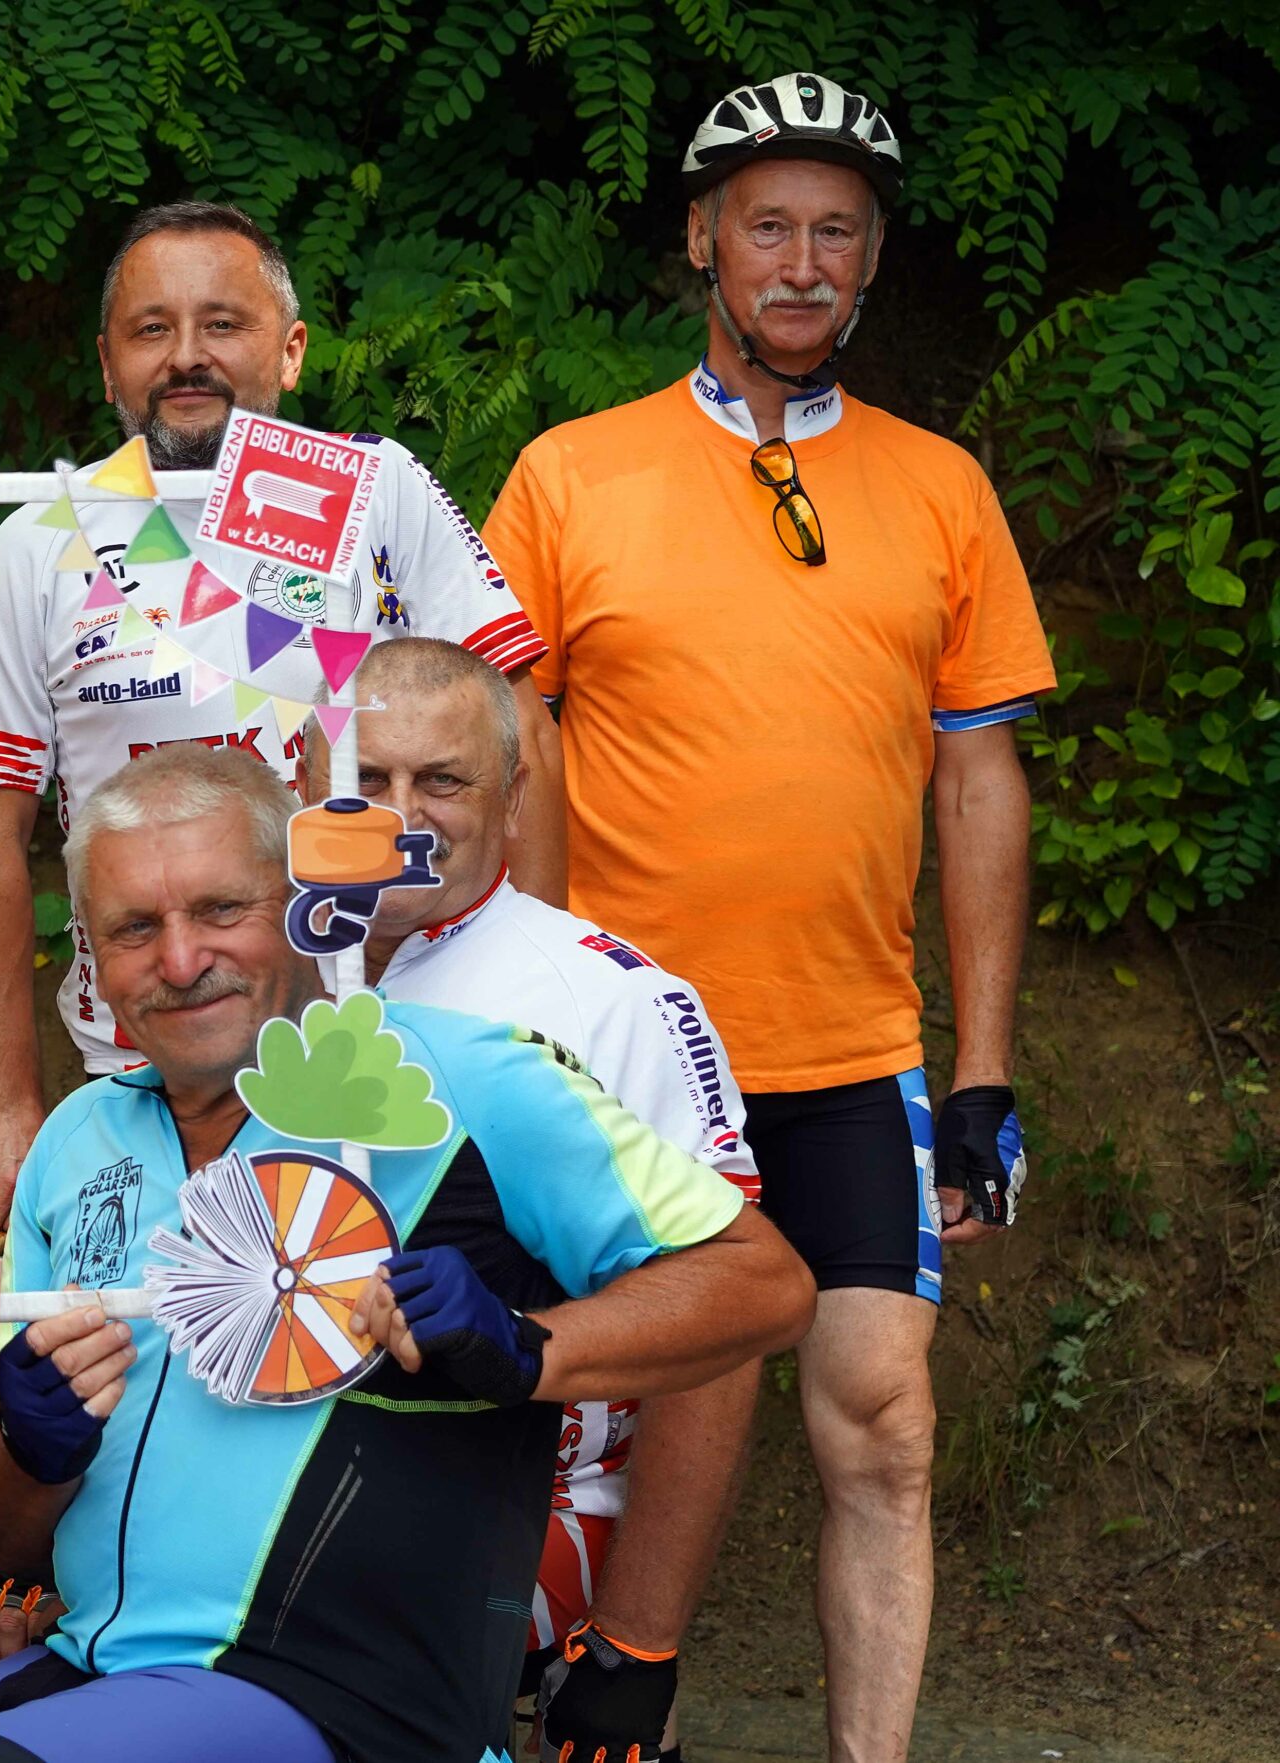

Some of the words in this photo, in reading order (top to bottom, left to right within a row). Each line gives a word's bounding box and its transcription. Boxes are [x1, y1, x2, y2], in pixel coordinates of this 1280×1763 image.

[248, 424, 360, 479] BIBLIOTEKA
[201, 417, 249, 539] PUBLICZNA
[353, 455, 381, 512] MIASTA
[244, 527, 326, 566] ŁAZACH
[334, 526, 361, 578] GMINY
[80, 1172, 140, 1200] KOLARSKI
[99, 1161, 131, 1184] KLUB
[94, 1267, 120, 1281] HUZY
